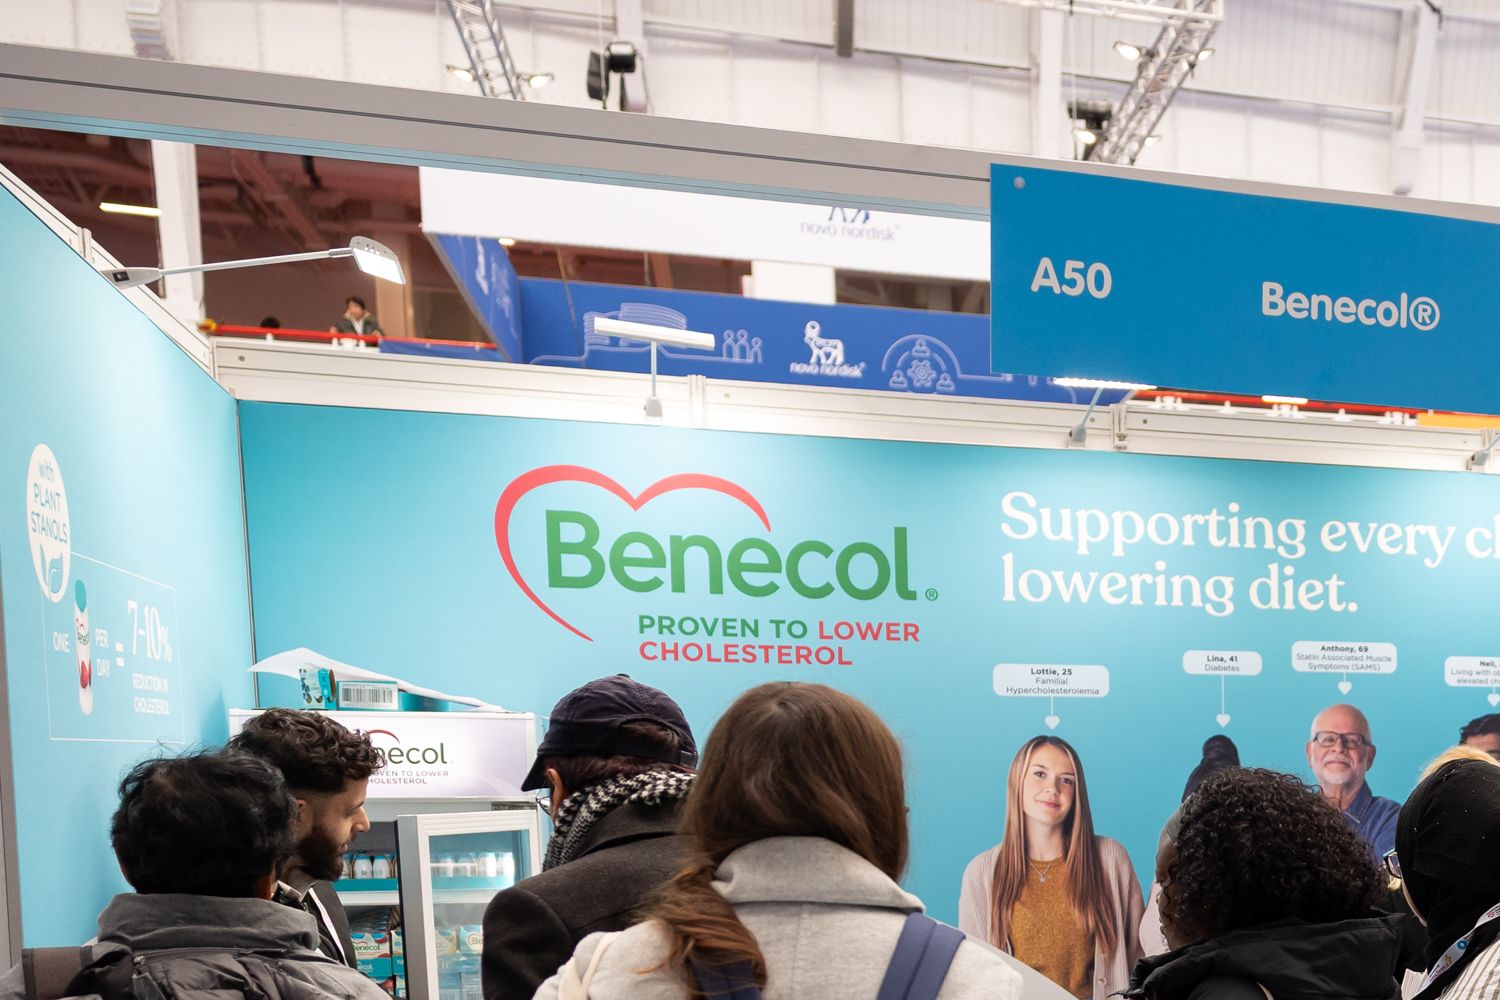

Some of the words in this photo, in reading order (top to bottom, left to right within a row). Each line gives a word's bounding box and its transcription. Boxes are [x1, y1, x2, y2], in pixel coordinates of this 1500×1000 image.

[800, 219, 838, 239] novo
[1031, 257, 1112, 299] A50
[1262, 281, 1440, 331] Benecol®
[790, 362, 819, 375] novo
[38, 460, 55, 482] with
[34, 483, 62, 515] PLANT
[31, 511, 68, 545] STANOLS
[1000, 490, 1307, 559] Supporting
[1320, 512, 1456, 568] every
[1001, 552, 1234, 616] lowering
[1249, 561, 1359, 613] diet.
[127, 600, 172, 663] 7-10%
[638, 614, 760, 638] PROVEN
[769, 618, 808, 639] TO
[818, 620, 920, 642] LOWER
[53, 634, 70, 653] ONE
[95, 628, 109, 647] PER
[1321, 644, 1356, 653] Anthony,
[1358, 645, 1369, 653] 69
[638, 641, 852, 665] CHOLESTEROL
[1206, 655, 1227, 664] Lina,
[1228, 655, 1238, 663] 41
[1296, 653, 1319, 662] Statin
[1321, 654, 1364, 663] Associated
[1366, 655, 1392, 663] Muscle
[97, 658, 110, 678] DAY
[1031, 667, 1060, 677] Lottie,
[1062, 668, 1072, 676] 25
[1204, 664, 1240, 672] Diabetes
[1308, 662, 1350, 671] Symptoms
[1351, 663, 1381, 672] (SAMS)
[1450, 668, 1473, 677] Living
[1475, 668, 1491, 676] with
[1479, 660, 1497, 668] Neil,
[1006, 686, 1100, 696] Hypercholesterolemia
[1035, 677, 1068, 685] Familial
[1457, 677, 1489, 685] elevated
[374, 742, 447, 764] necol
